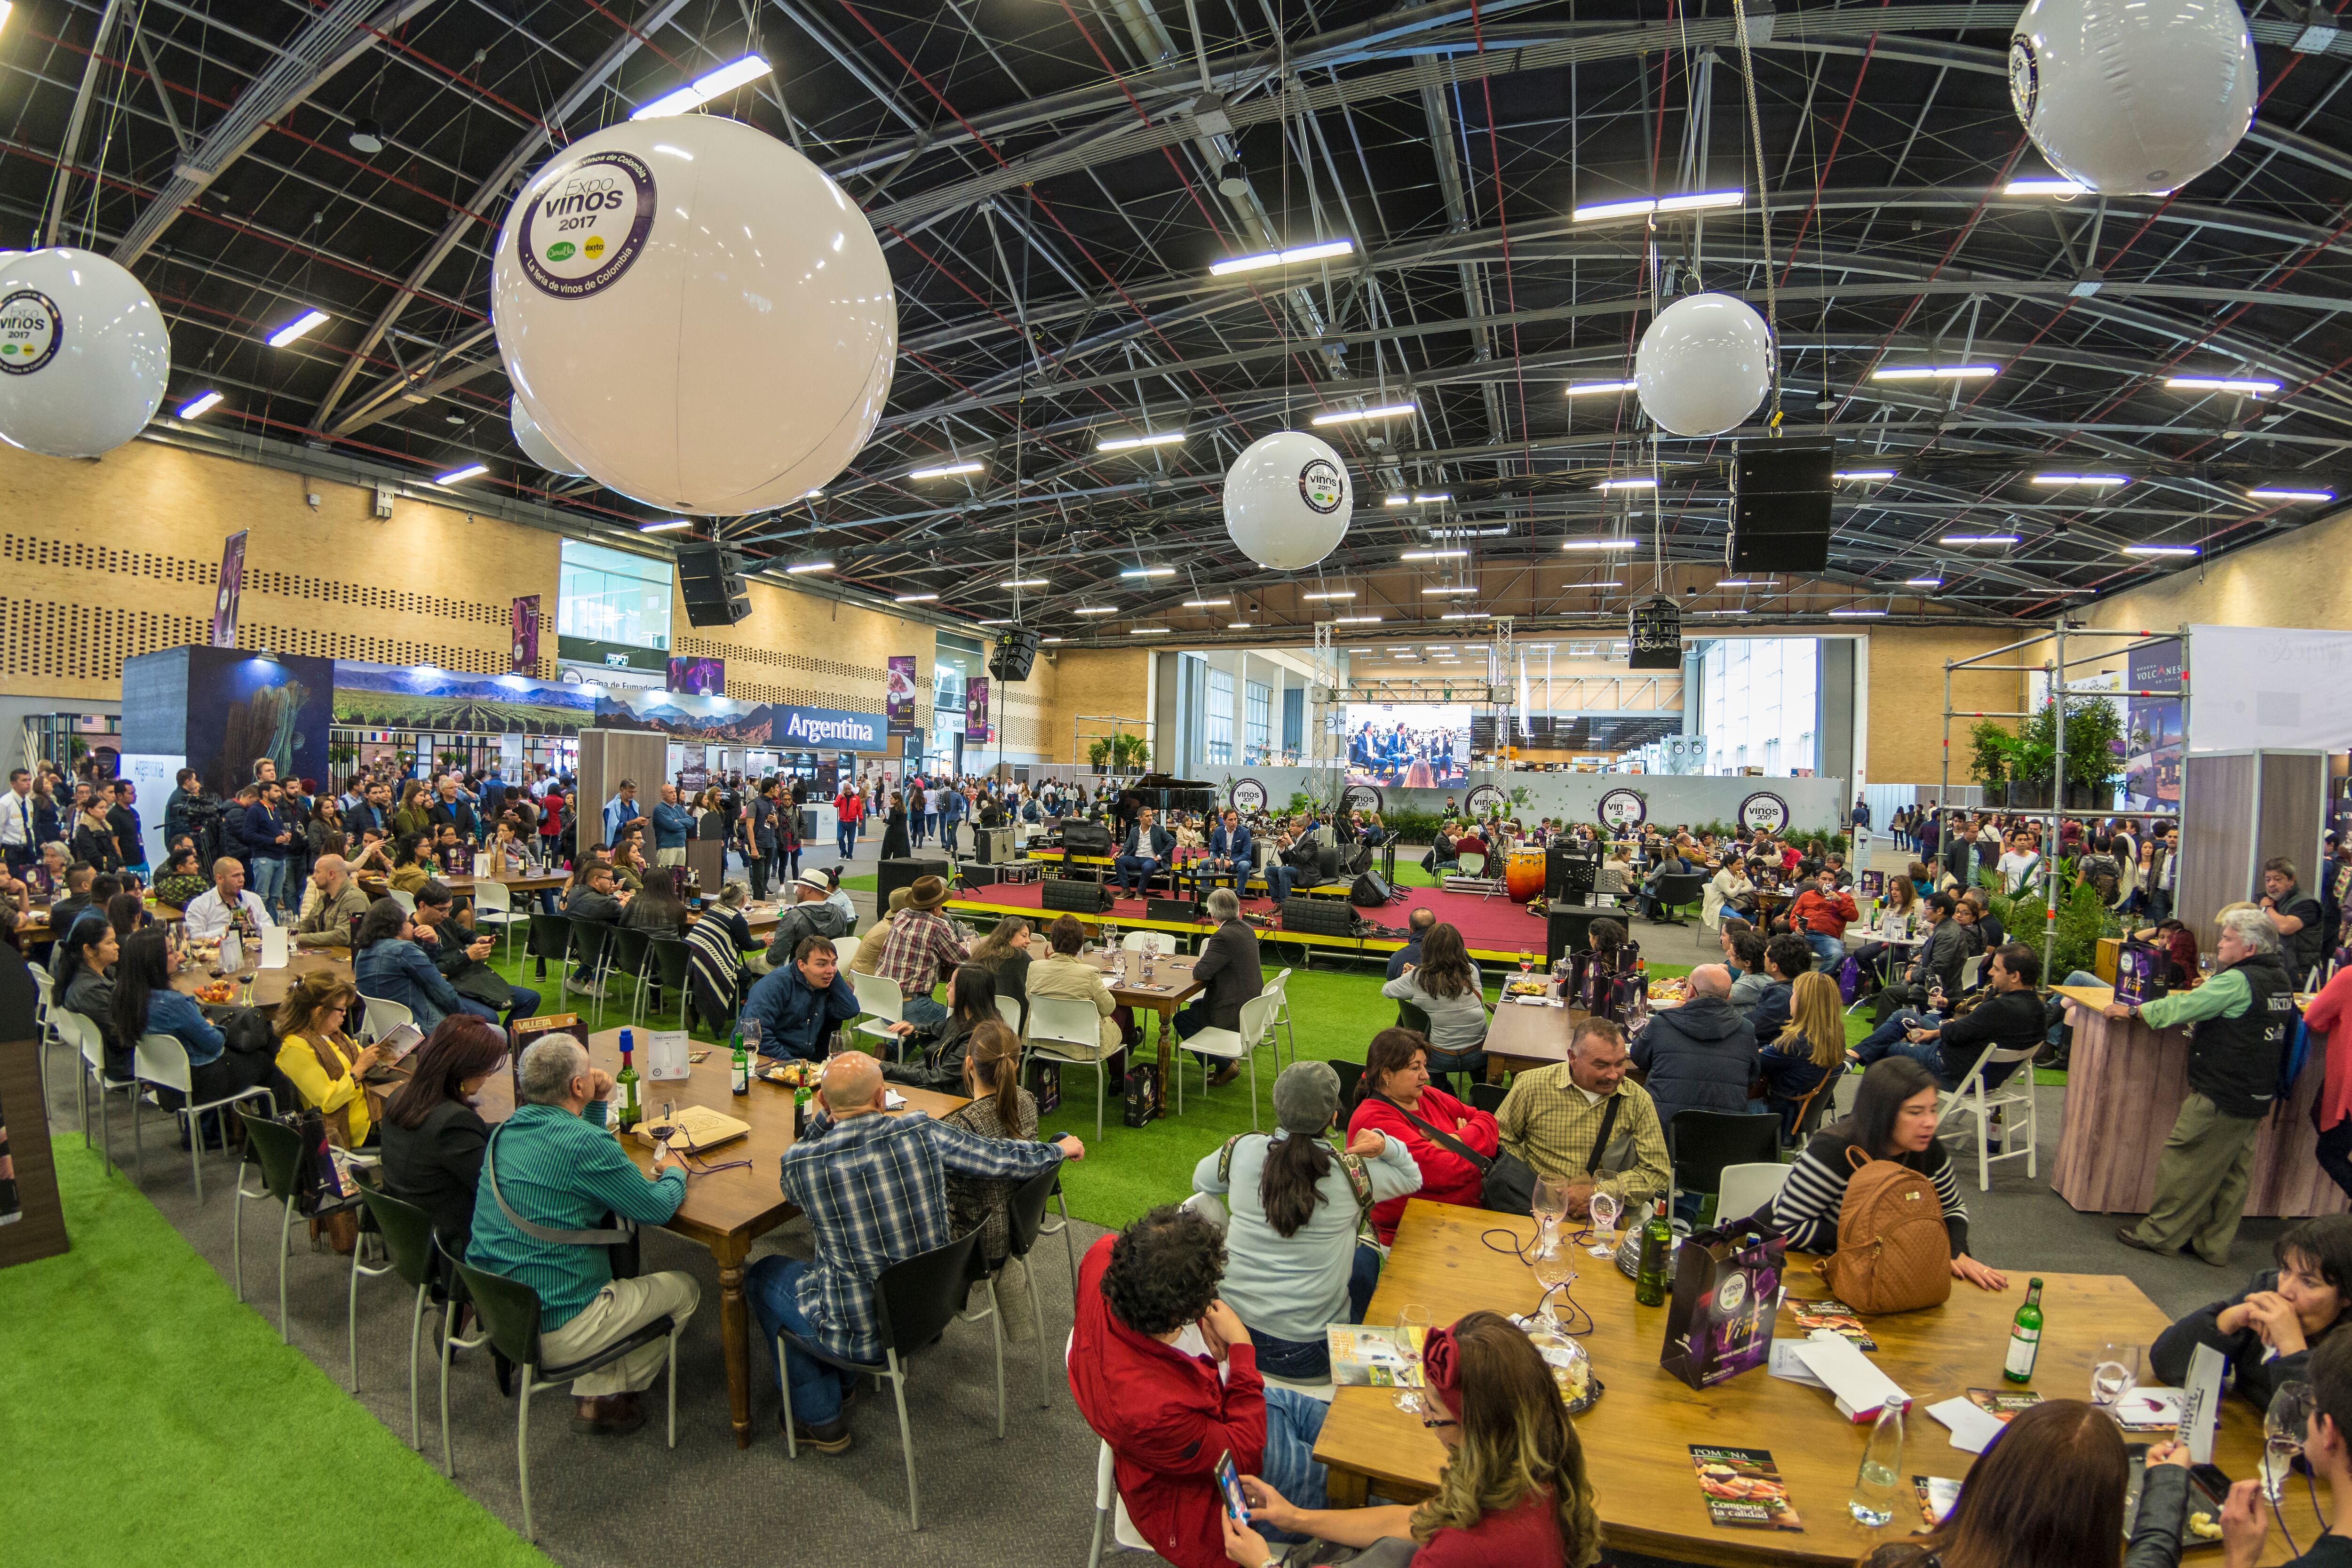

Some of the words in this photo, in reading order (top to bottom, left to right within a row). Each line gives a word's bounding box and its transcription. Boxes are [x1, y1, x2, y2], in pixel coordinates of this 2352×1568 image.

[618, 155, 646, 178] Colombia
[565, 178, 613, 197] Expo
[546, 190, 623, 218] vinos
[558, 215, 597, 231] 2017
[548, 246, 574, 257] Carulla
[585, 244, 604, 253] éxito
[527, 259, 536, 272] La
[534, 269, 548, 287] feria
[549, 281, 559, 291] de
[560, 284, 583, 293] vinos
[585, 281, 596, 290] de
[596, 247, 633, 285] Colombia
[10, 307, 39, 318] Expo
[0, 317, 45, 331] vinos
[1310, 475, 1336, 486] vinos
[2137, 665, 2182, 680] VOLCANES
[787, 713, 873, 743] Argentina
[518, 1018, 552, 1030] VILLETA
[1724, 1282, 1743, 1294] vinos
[1331, 1331, 1342, 1362] EXTREMO
[1340, 1332, 1350, 1359] DESTINO
[1694, 1449, 1749, 1459] POMONA
[1711, 1501, 1764, 1511] Comparte
[1728, 1510, 1769, 1519] calidad
